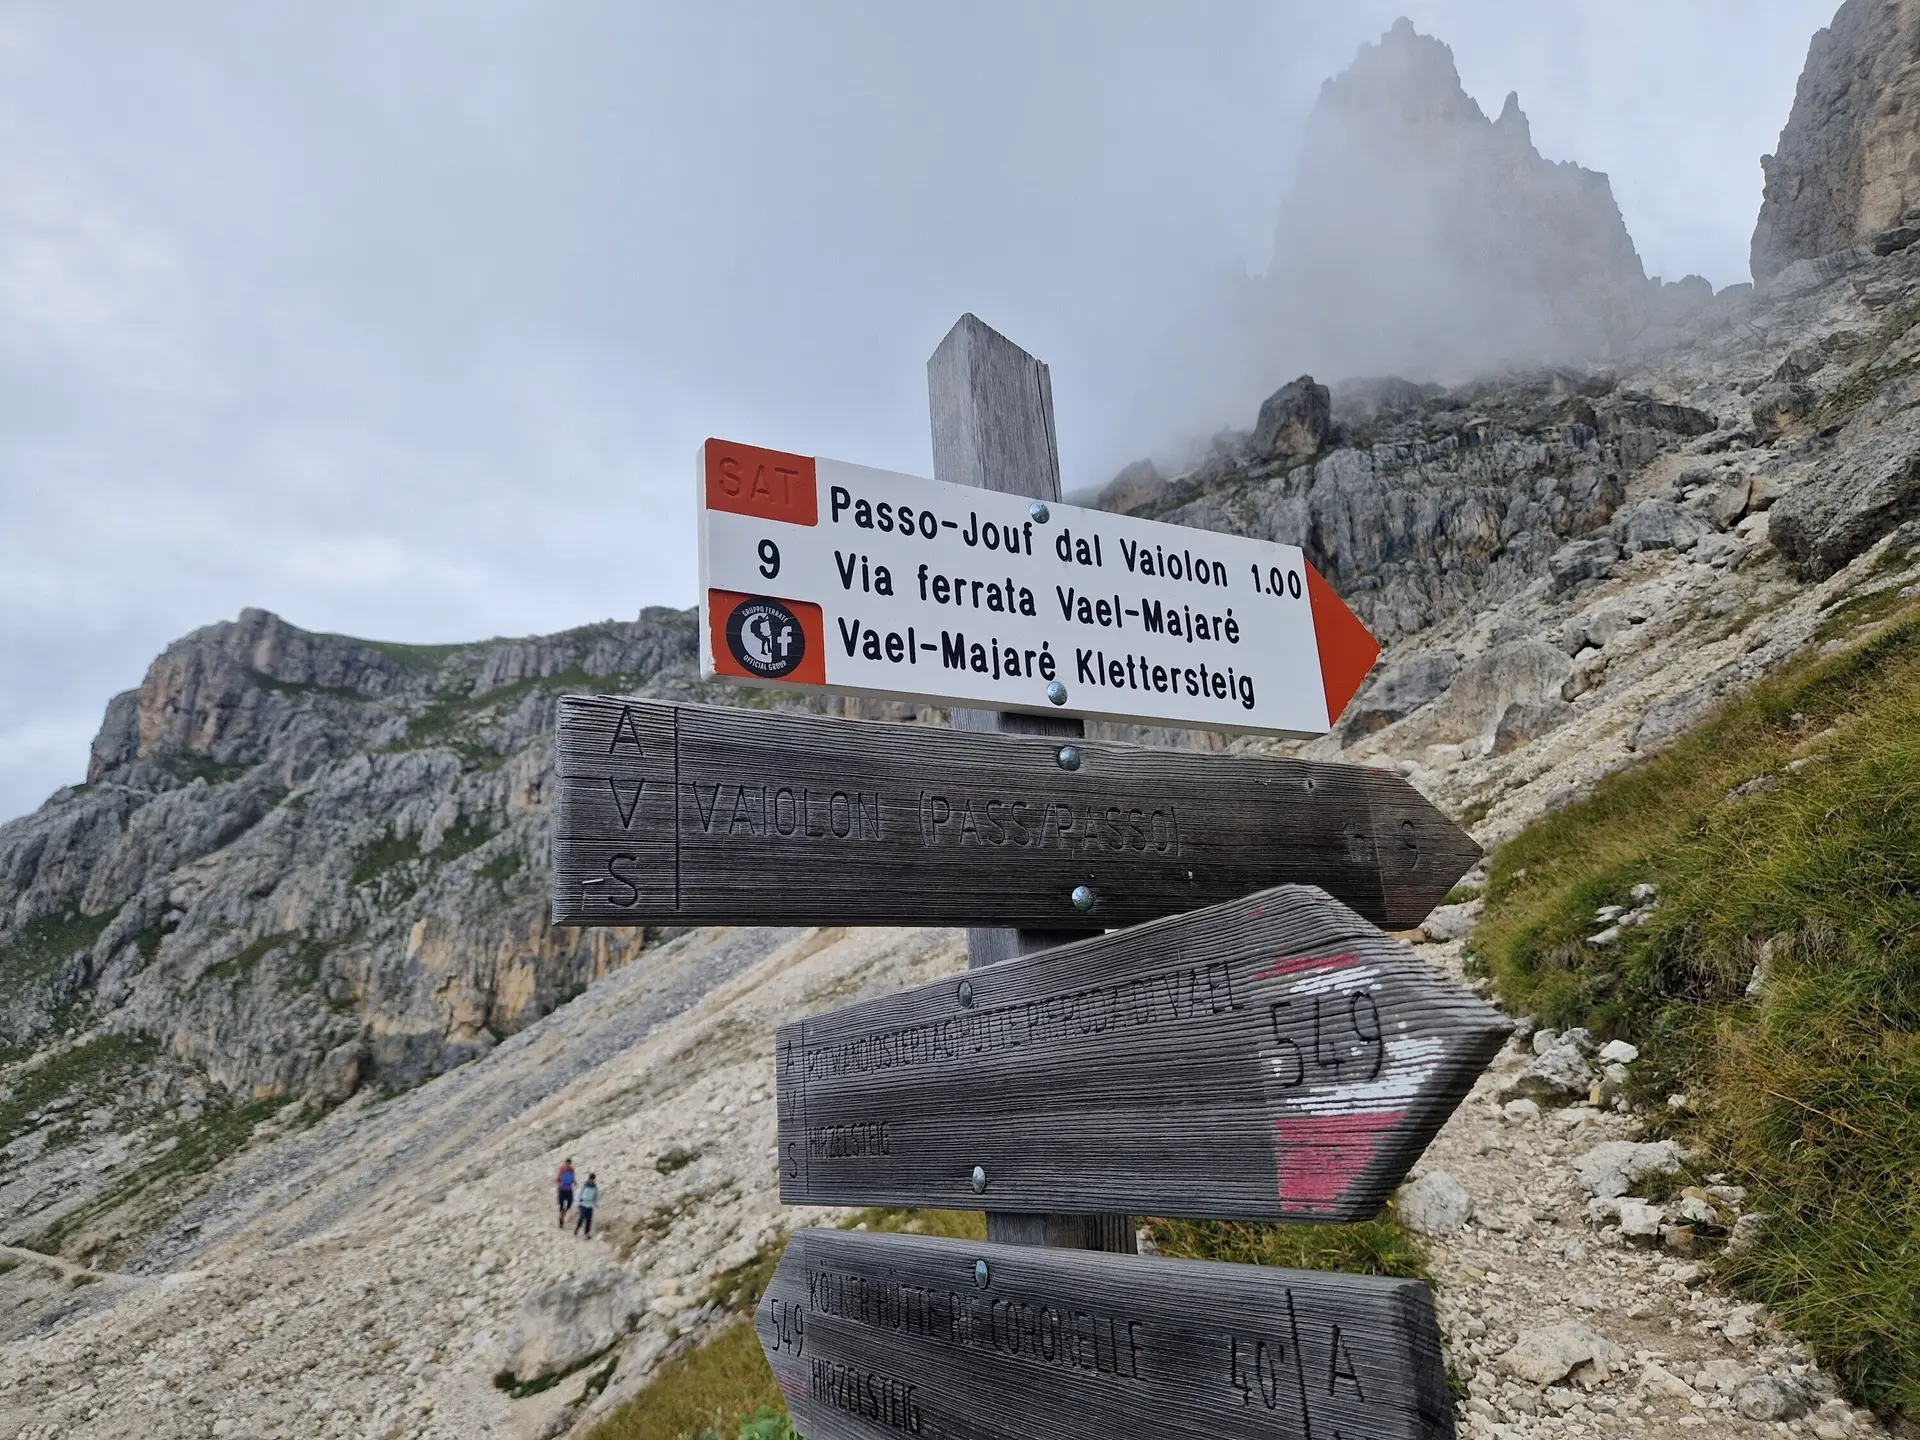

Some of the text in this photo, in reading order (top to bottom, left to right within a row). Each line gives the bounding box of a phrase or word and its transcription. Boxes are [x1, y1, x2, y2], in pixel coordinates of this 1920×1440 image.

[718, 457, 799, 508] SAT
[757, 539, 781, 580] 9
[830, 486, 1301, 600] Passo-Jouf dal Vaiolon 1.00
[741, 606, 789, 624] GRUPPO FERRATE
[834, 550, 1240, 644] Via ferrata Vael-Majaré
[743, 654, 787, 671] OFFICIAL GROUP
[777, 625, 792, 657] f
[837, 616, 1256, 710] Vael-Majaré Klettersteig
[693, 780, 881, 841] VAIOLON
[1270, 990, 1384, 1088] 549
[770, 1298, 804, 1358] 549
